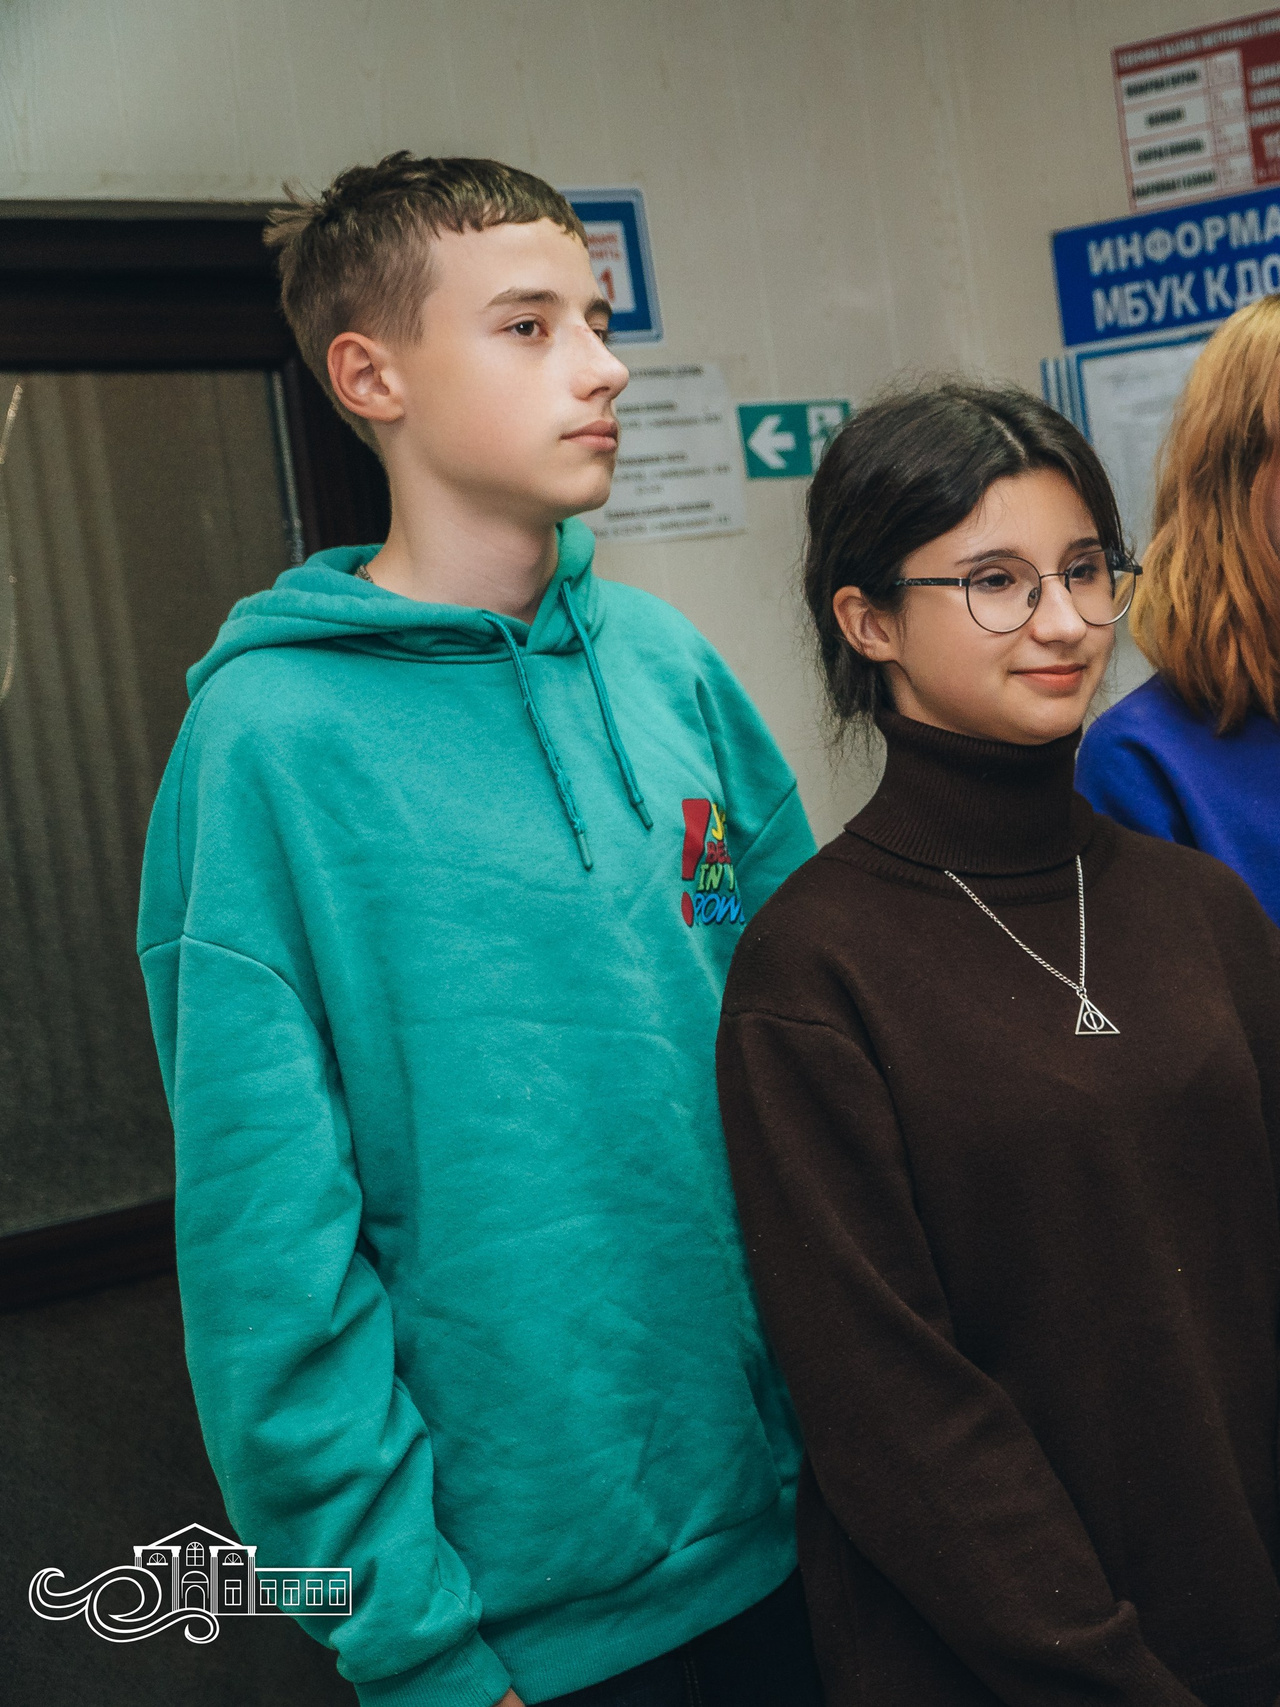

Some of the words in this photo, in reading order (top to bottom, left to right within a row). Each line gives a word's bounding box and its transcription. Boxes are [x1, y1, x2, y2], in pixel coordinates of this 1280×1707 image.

[1091, 271, 1200, 333] МБУК
[706, 841, 731, 863] BE
[698, 863, 723, 891] IN
[695, 892, 745, 925] POW
